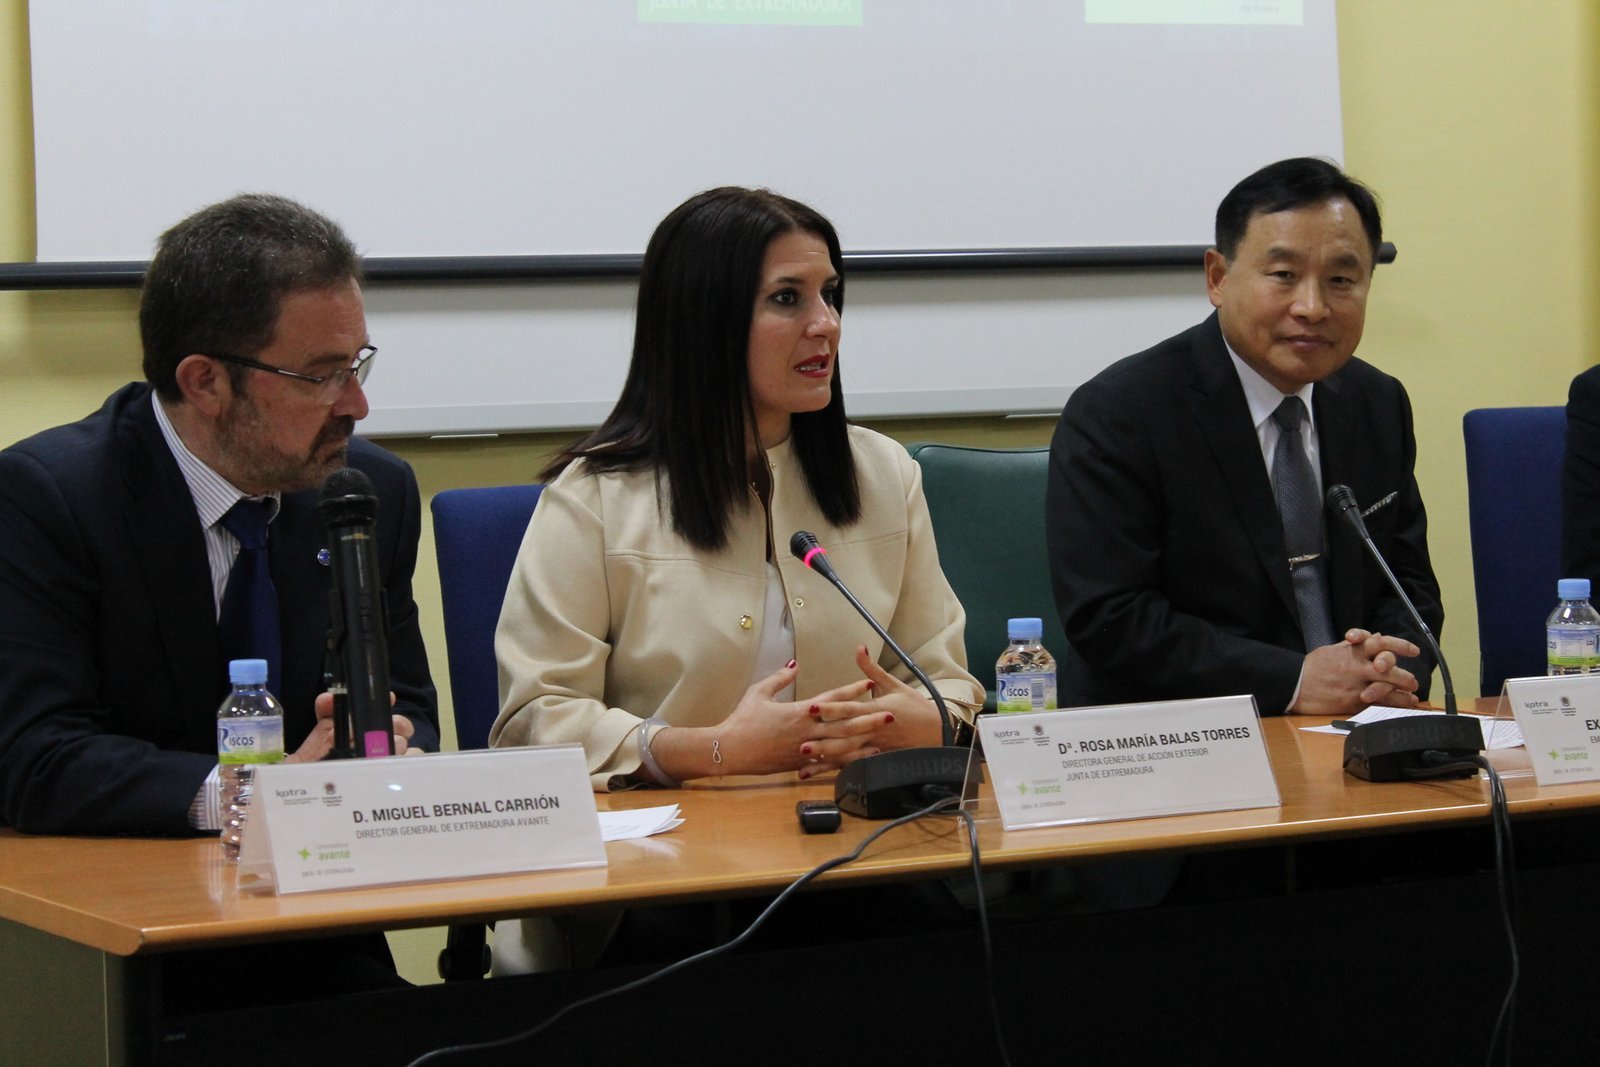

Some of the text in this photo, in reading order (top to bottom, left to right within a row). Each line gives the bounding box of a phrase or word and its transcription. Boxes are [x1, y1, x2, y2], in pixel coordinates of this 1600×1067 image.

[1080, 739, 1115, 753] ROSA
[1116, 733, 1159, 750] MARÍA
[1160, 731, 1200, 746] BALAS
[1202, 727, 1250, 742] TORRES
[1062, 757, 1102, 769] DIRECTORA
[1103, 754, 1137, 766] GENERAL
[1137, 753, 1148, 762] DE
[1175, 747, 1209, 759] EXTERIOR
[1066, 771, 1090, 782] JUNTA
[1091, 769, 1102, 779] DE
[1102, 766, 1155, 778] EXTREMADURA
[353, 794, 560, 823] D. MIGUEL BERNAL CARRIÓN
[356, 816, 550, 839] DIRECTOR GENERAL DE EXTREMADURA AVANTE
